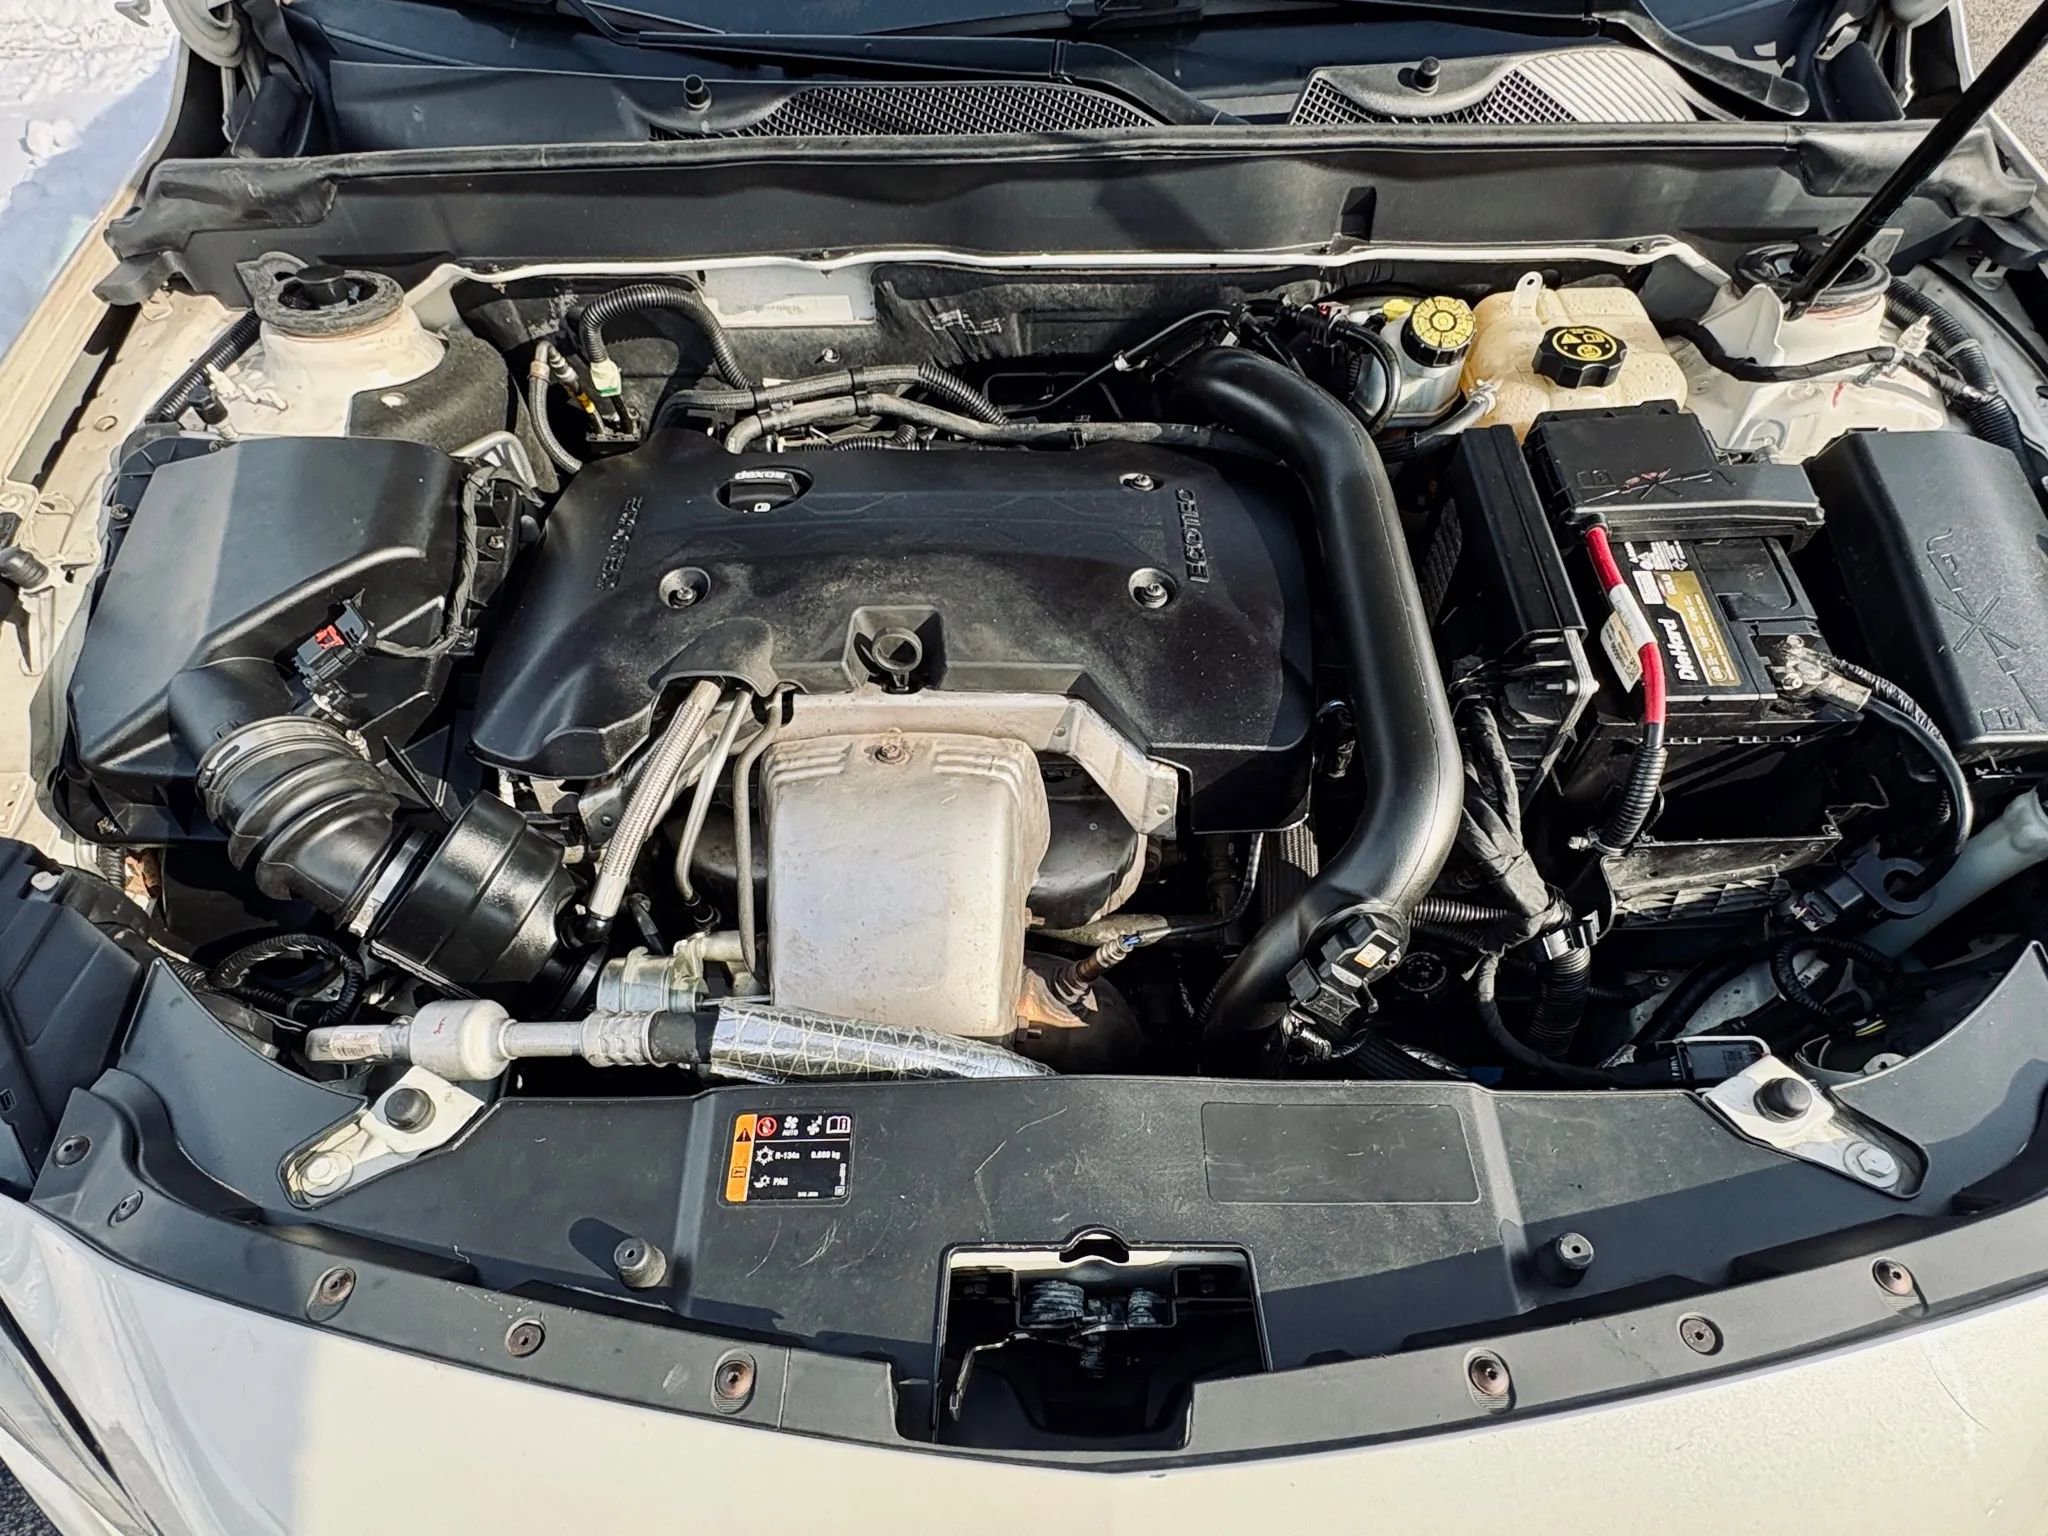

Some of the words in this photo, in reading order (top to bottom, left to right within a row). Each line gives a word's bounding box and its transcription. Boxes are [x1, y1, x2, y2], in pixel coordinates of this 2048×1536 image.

[735, 470, 787, 480] dexos
[1174, 487, 1210, 583] ECOTEC
[1657, 618, 1699, 681] DieHard
[773, 1177, 788, 1185] PAG
